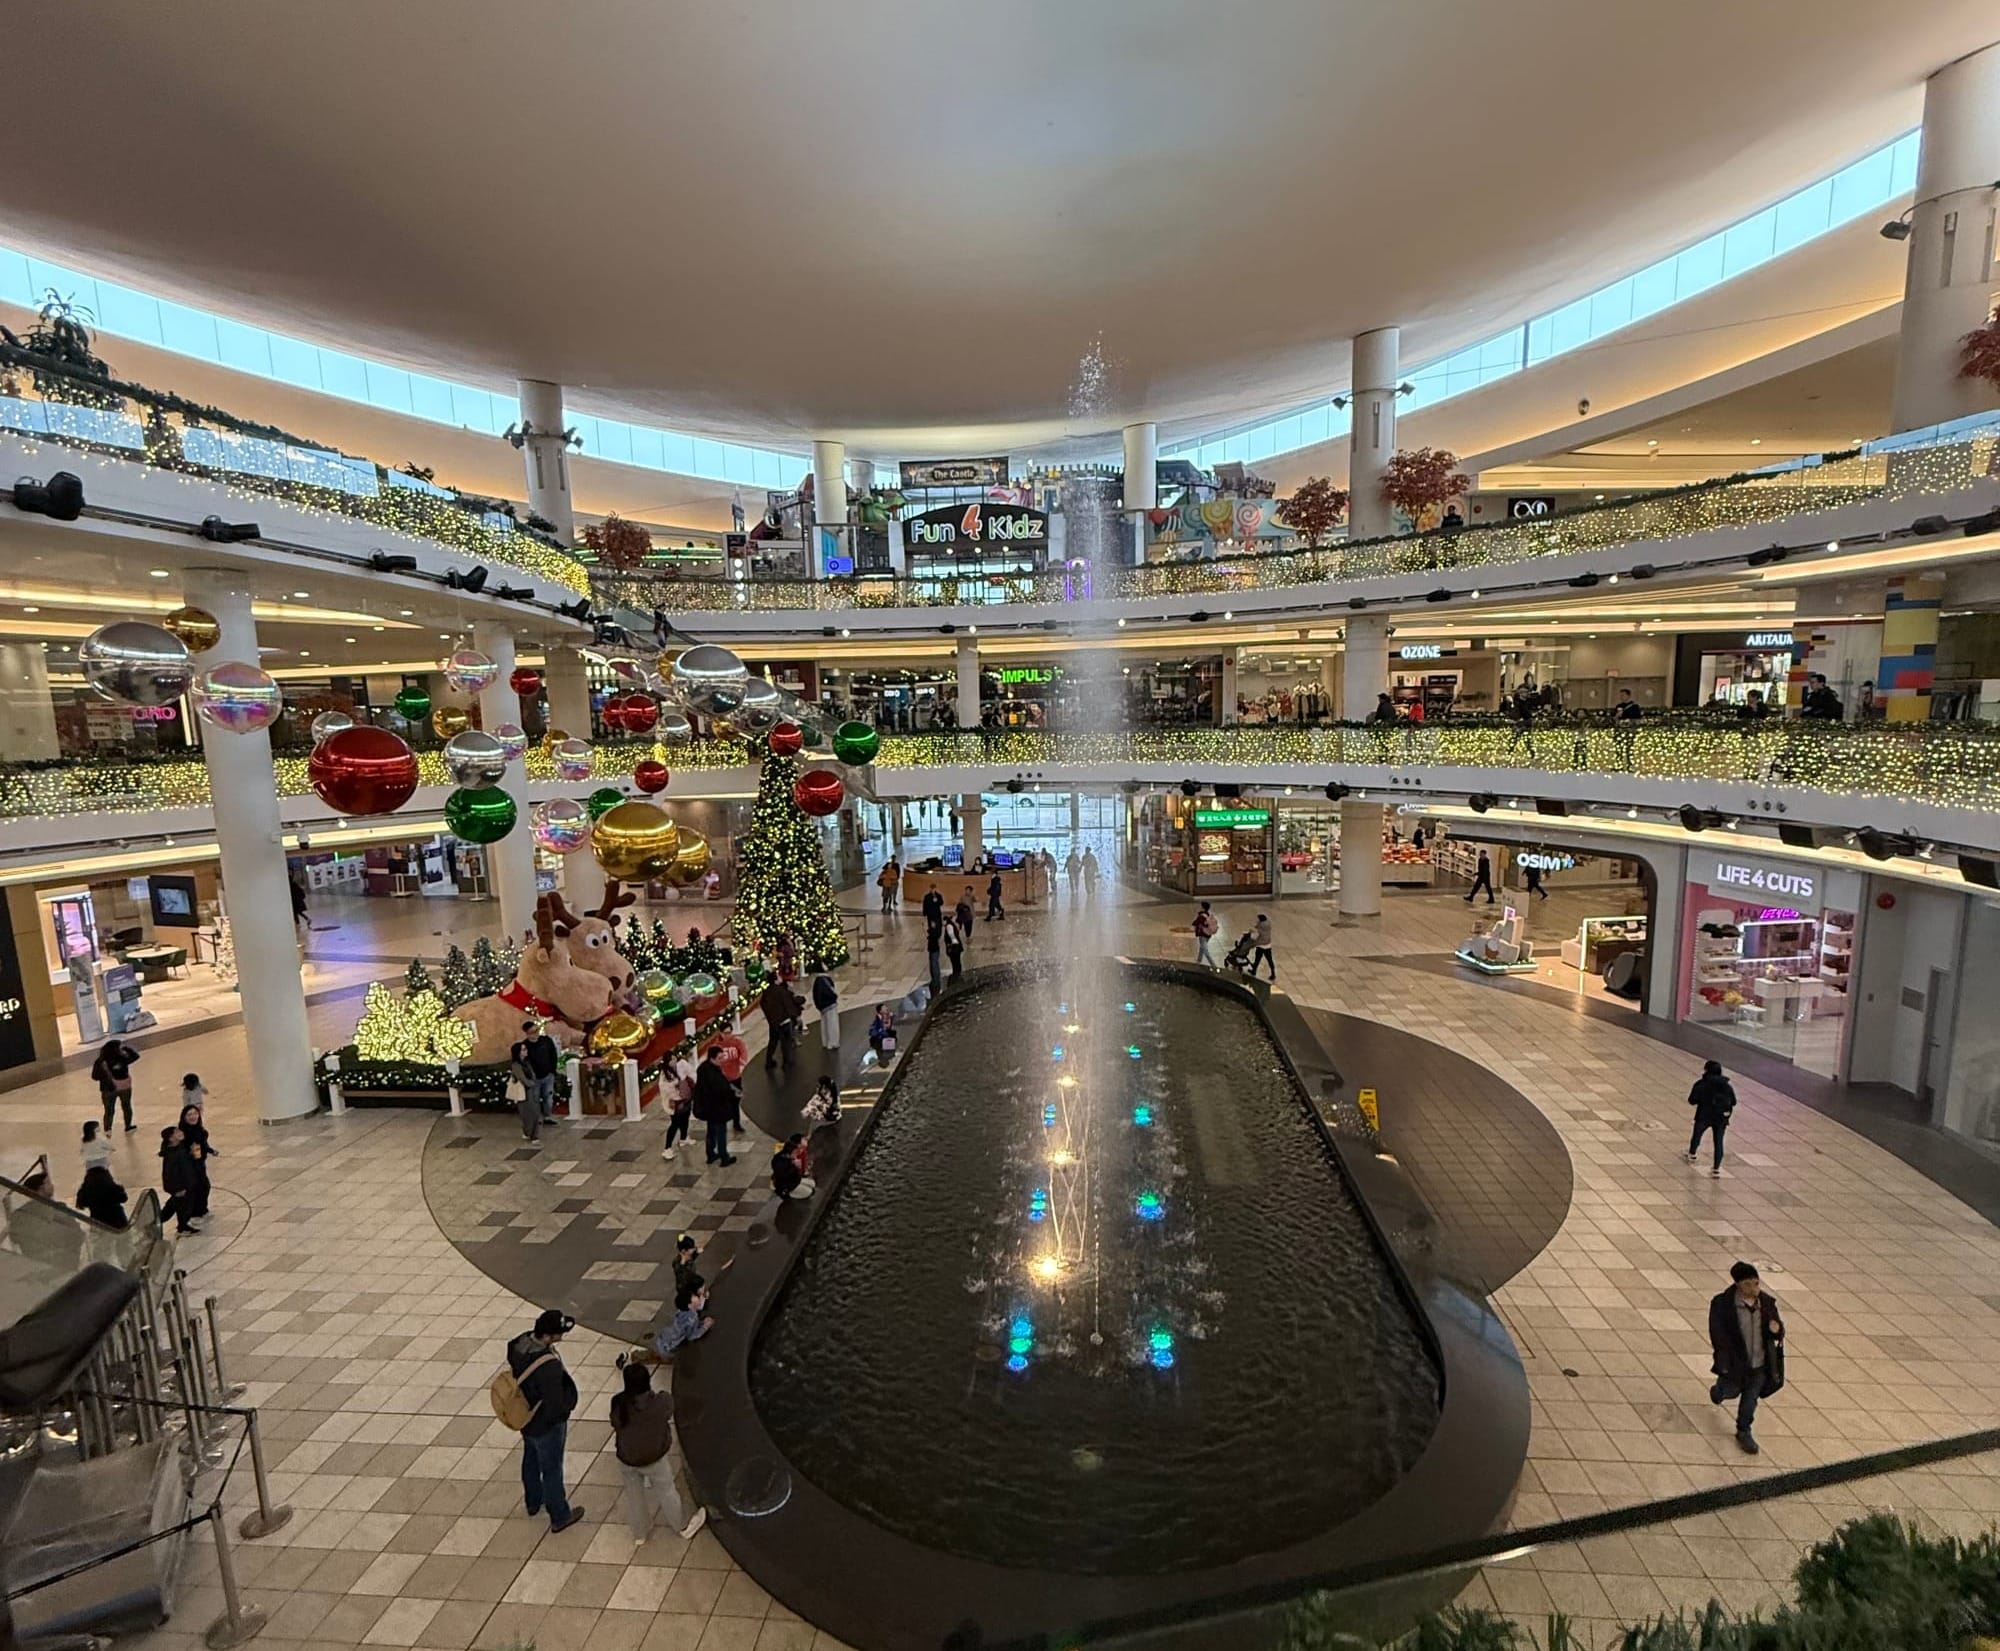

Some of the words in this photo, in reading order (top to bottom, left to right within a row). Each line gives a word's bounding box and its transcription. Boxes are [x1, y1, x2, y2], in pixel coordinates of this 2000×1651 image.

[933, 468, 949, 479] The
[950, 468, 976, 478] Castle
[911, 519, 956, 543] Fun
[961, 503, 983, 541] 4
[988, 513, 1045, 540] Kidz
[1401, 645, 1441, 659] OZONE
[1517, 852, 1561, 871] OSIM
[1717, 863, 1751, 886] LIFE
[1751, 869, 1765, 888] 4
[1766, 872, 1814, 897] CUTS
